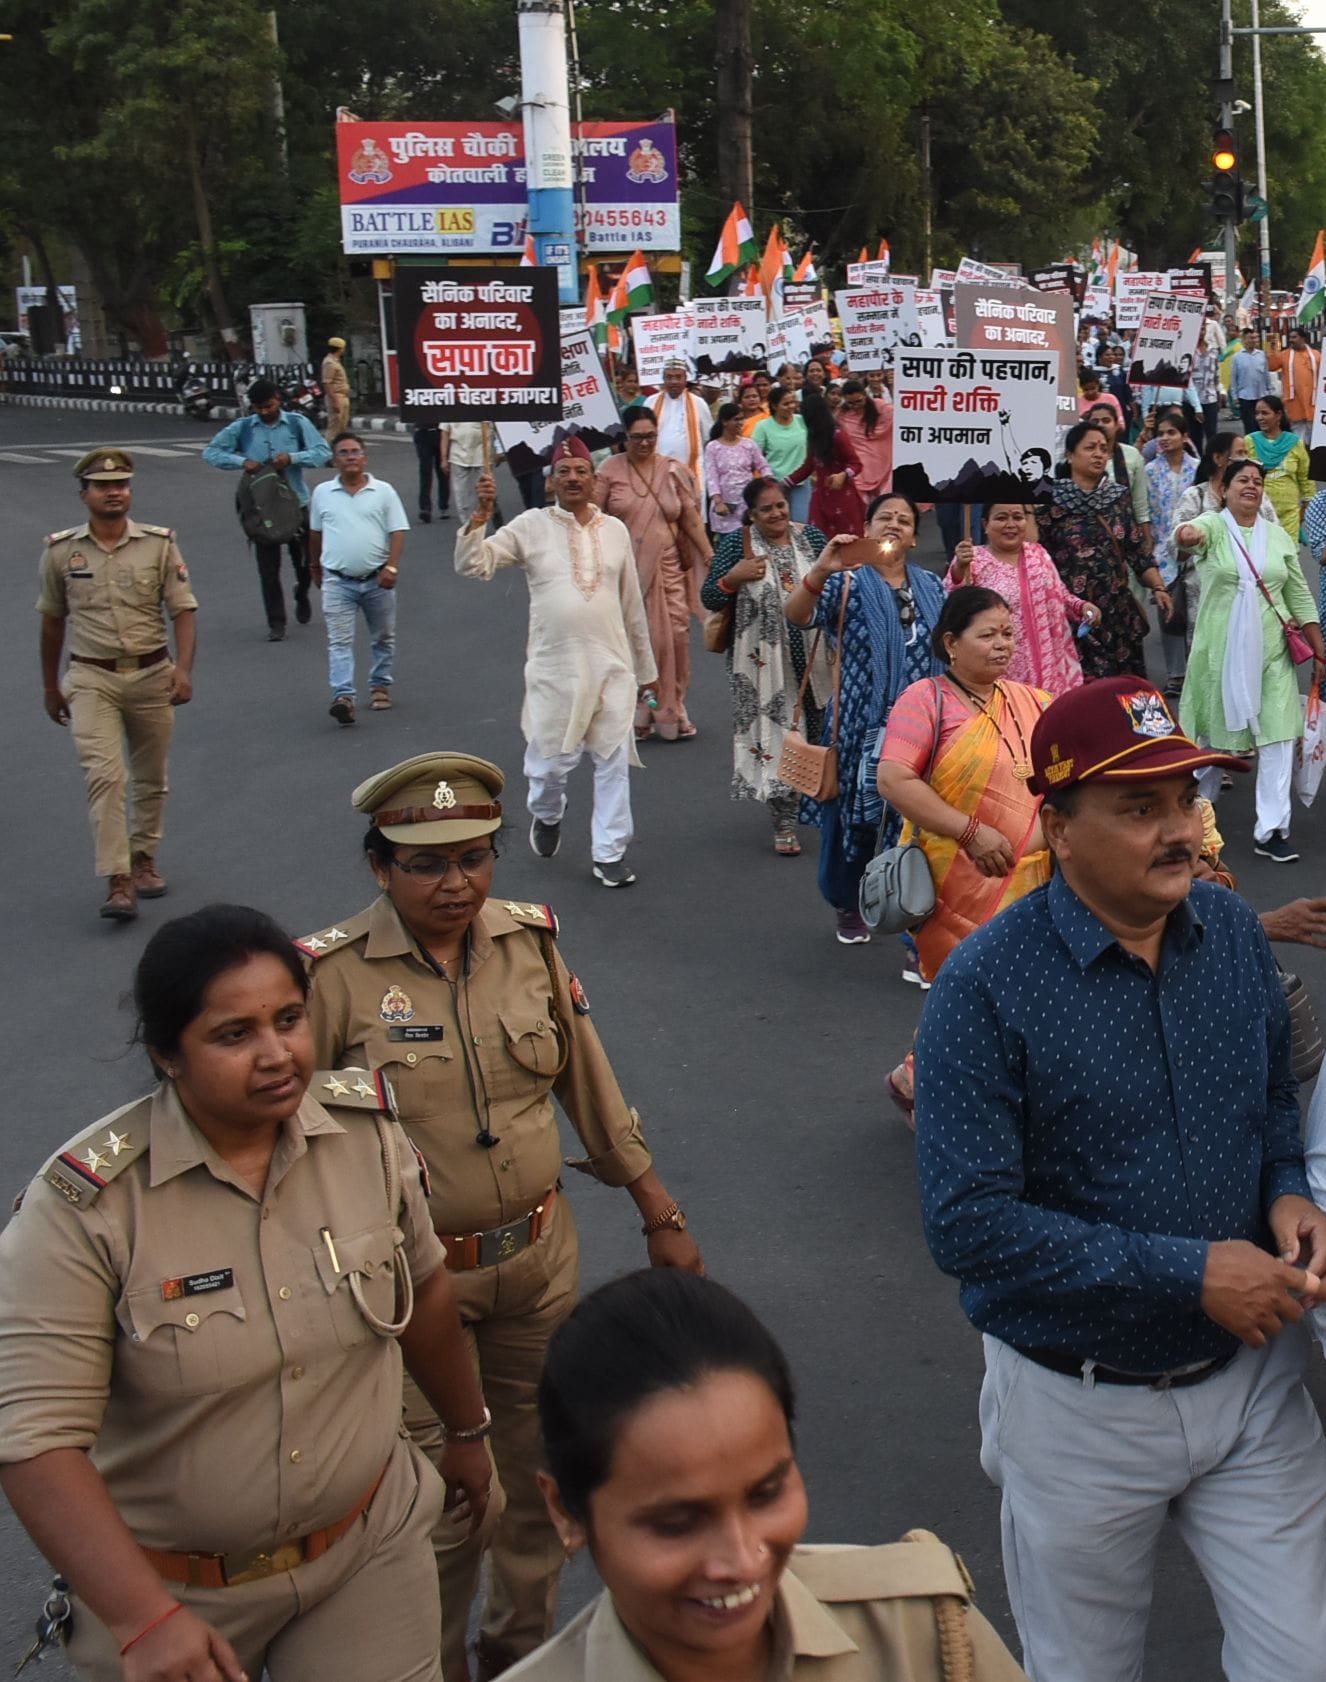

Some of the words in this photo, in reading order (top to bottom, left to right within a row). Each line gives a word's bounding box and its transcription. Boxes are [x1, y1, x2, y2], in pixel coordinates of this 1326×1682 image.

[388, 132, 455, 164] पुलिस
[461, 132, 517, 157] चौकी
[425, 163, 509, 183] कोतवाली
[352, 212, 434, 232] BATTLE
[439, 212, 474, 232] IAS
[589, 232, 627, 242] Battle
[631, 232, 653, 242] IAS
[420, 280, 475, 302] सैनिक
[477, 281, 534, 302] परिवार
[846, 290, 888, 308] महापौर
[433, 312, 457, 329] का
[460, 312, 522, 332] अनादर,
[974, 298, 1014, 319] सैनिक
[1016, 303, 1056, 324] परिवार
[984, 325, 1002, 341] का
[1004, 327, 1049, 348] अनादर,
[422, 341, 489, 376] सपा
[490, 341, 536, 375] का
[900, 357, 944, 378] सपा
[948, 352, 976, 379] की
[980, 359, 1055, 384] पहचान,
[404, 383, 455, 405] असली
[457, 383, 497, 405] चेहरा
[899, 384, 947, 411] नारी
[952, 386, 1001, 412] शक्ति
[899, 426, 923, 443] का
[927, 427, 992, 445] अपमान
